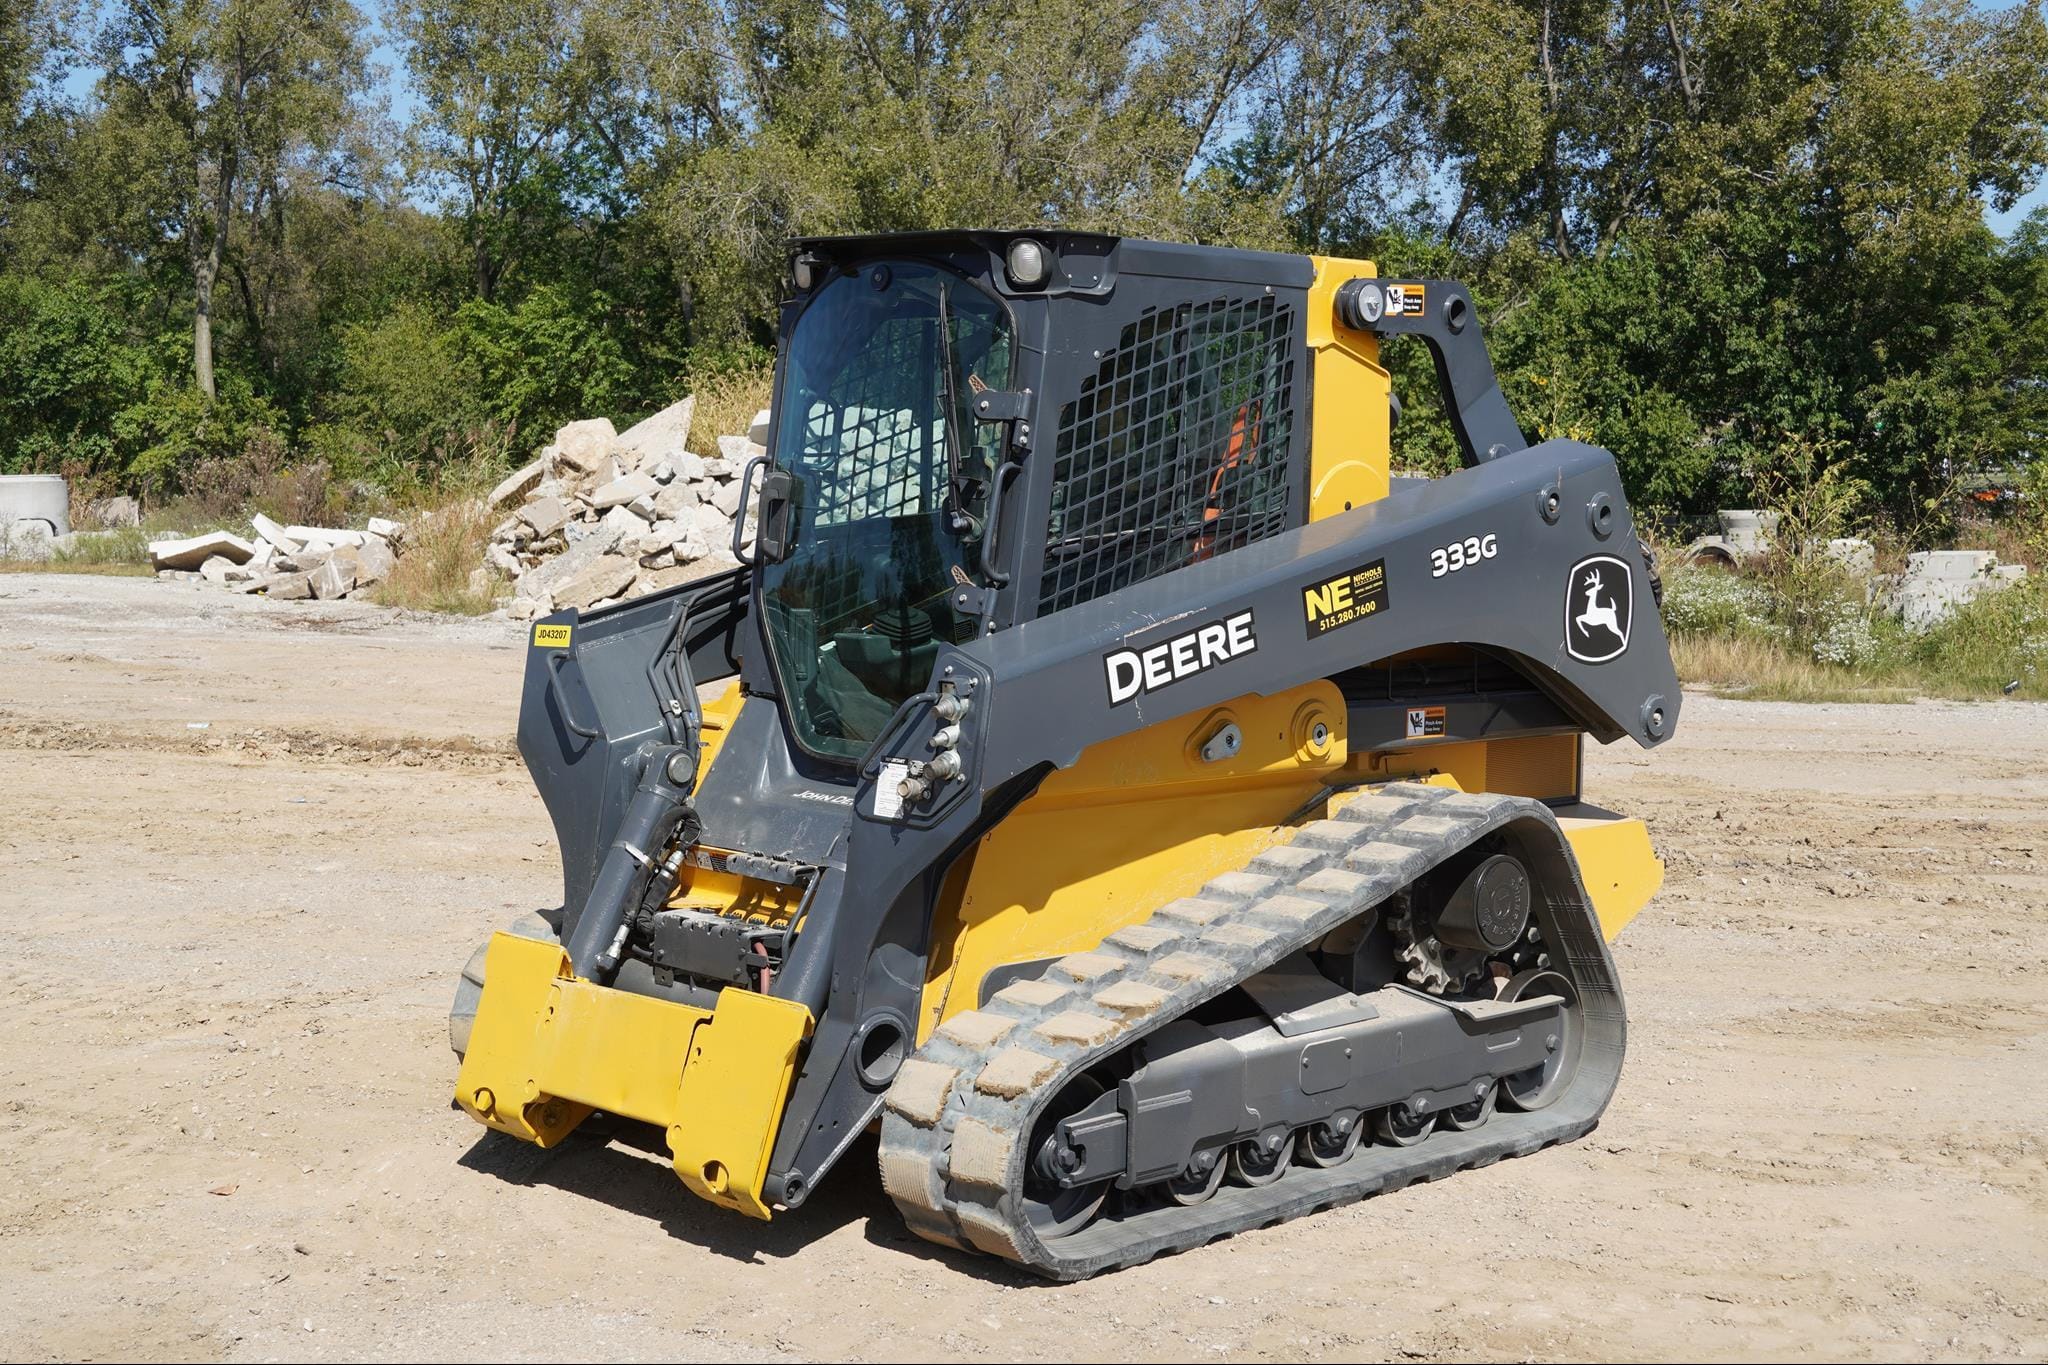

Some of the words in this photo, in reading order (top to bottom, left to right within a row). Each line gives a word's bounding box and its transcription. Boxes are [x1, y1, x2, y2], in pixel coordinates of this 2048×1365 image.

[1431, 533, 1497, 577] 333G
[1353, 566, 1382, 583] NICHOLS
[1305, 576, 1353, 622] NE
[1320, 601, 1376, 631] 515.280.7600
[538, 629, 568, 639] JD43207
[1106, 612, 1255, 703] DEERE
[792, 790, 834, 802] JOHN
